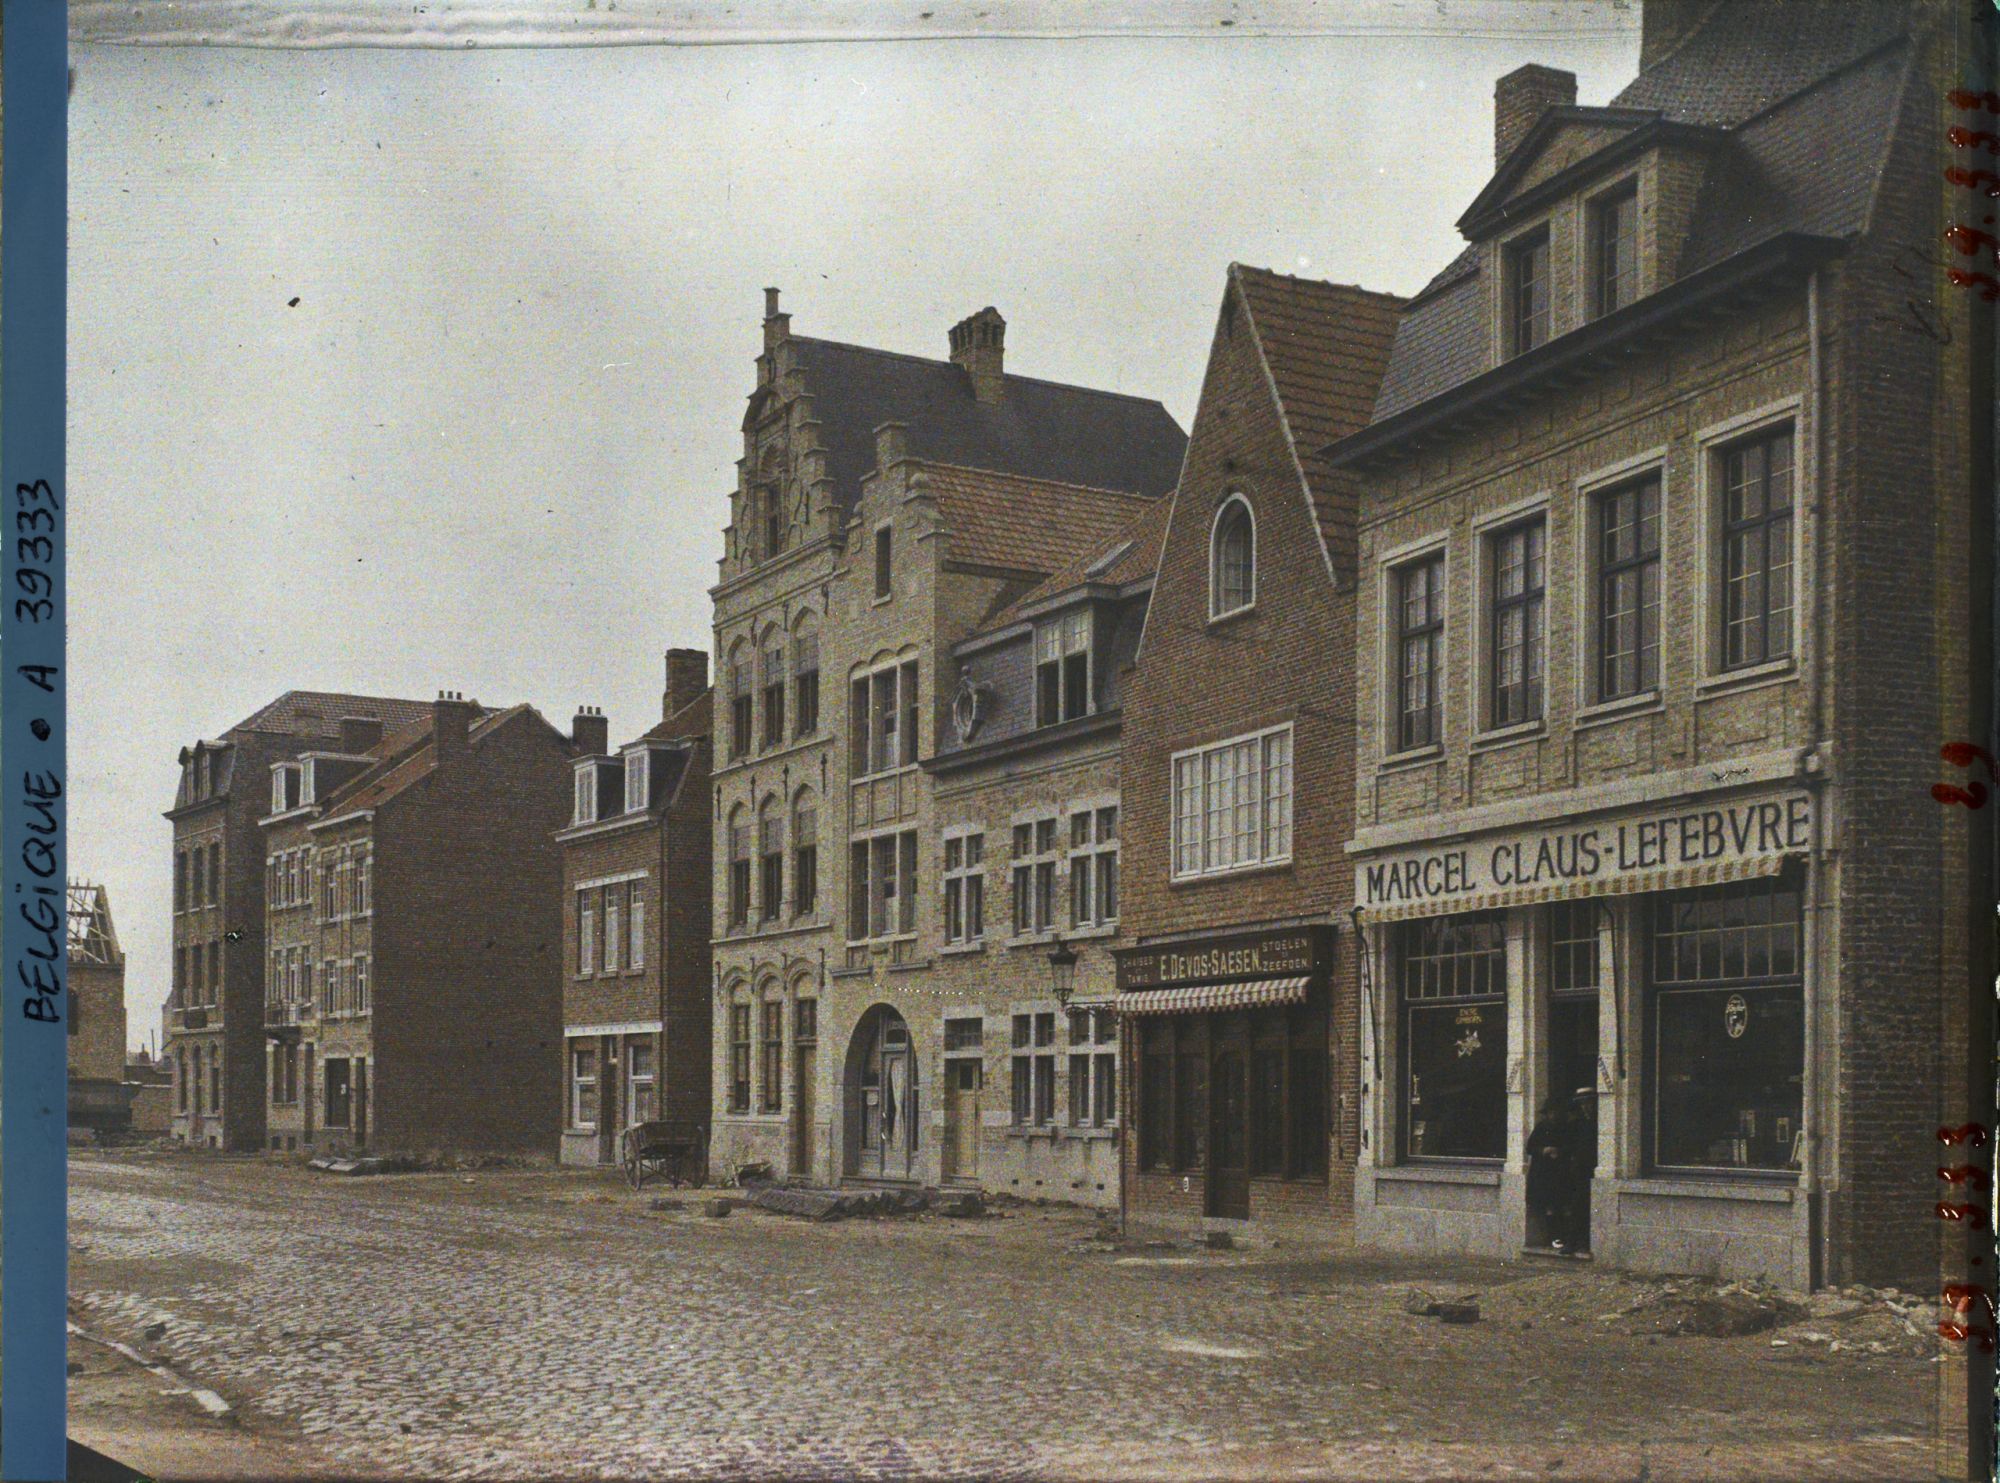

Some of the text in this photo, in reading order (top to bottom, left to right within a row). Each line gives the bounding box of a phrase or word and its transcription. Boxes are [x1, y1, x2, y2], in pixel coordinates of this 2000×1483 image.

[15, 478, 60, 624] 39333
[18, 664, 58, 693] A
[1366, 795, 1810, 904] MARCEL CLAUS-LEFEBVRE
[1262, 938, 1308, 953] STOELEN
